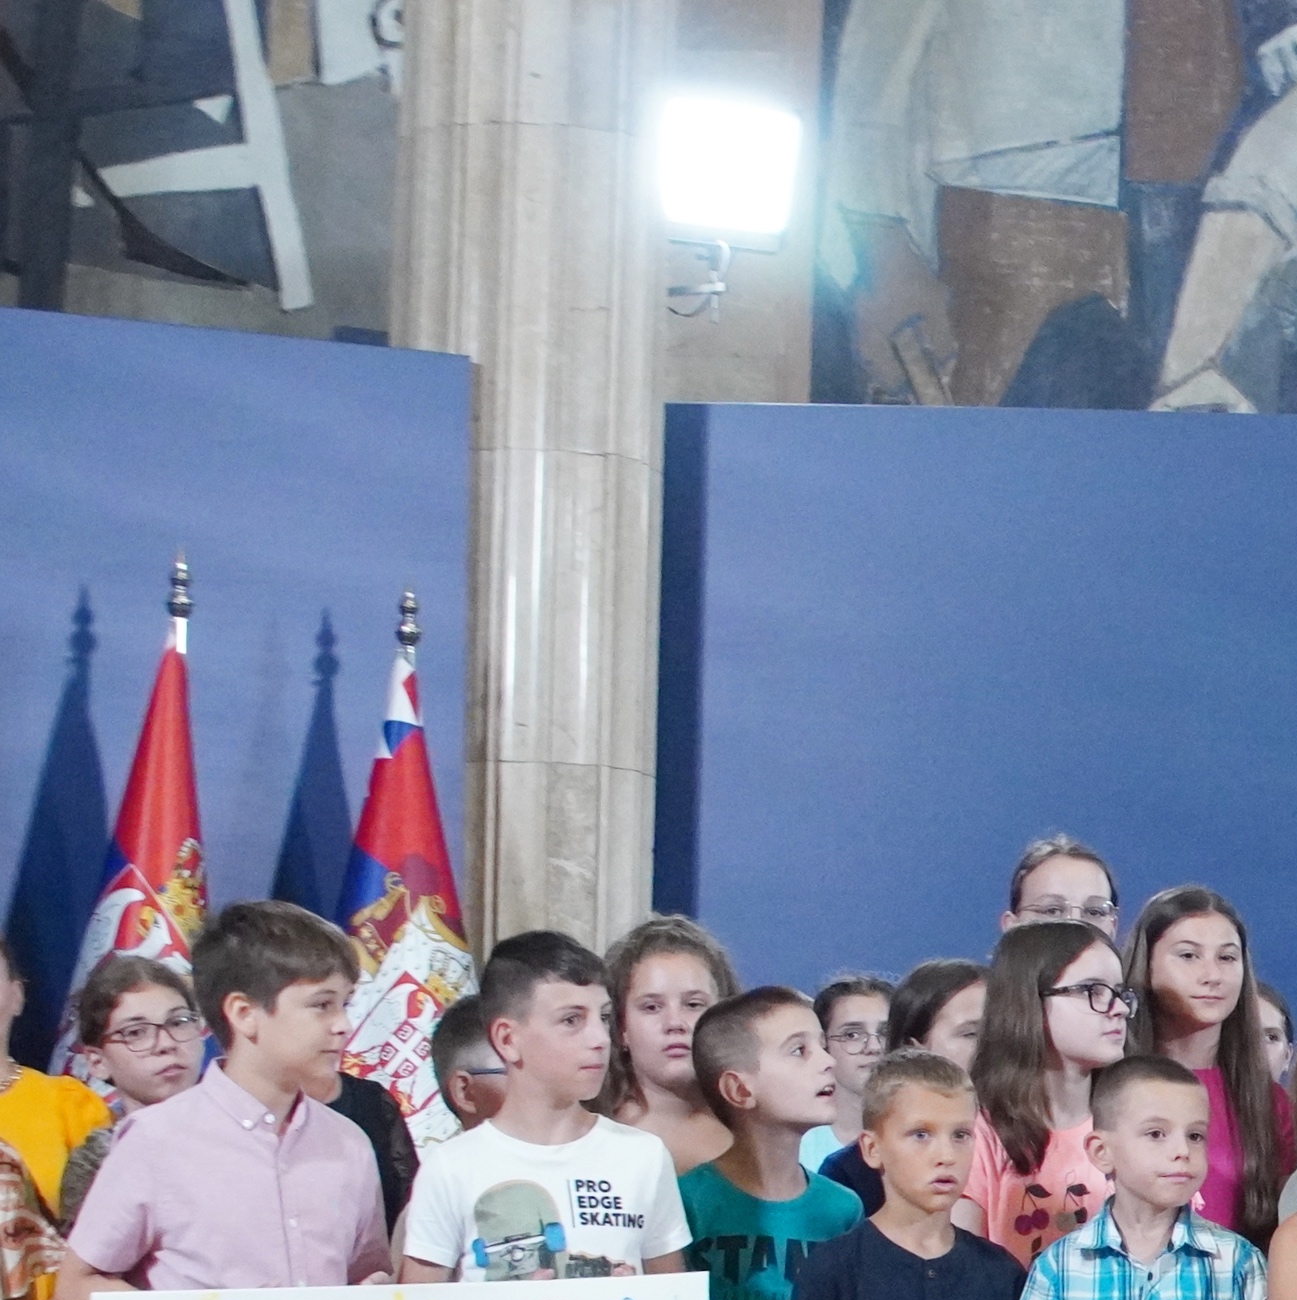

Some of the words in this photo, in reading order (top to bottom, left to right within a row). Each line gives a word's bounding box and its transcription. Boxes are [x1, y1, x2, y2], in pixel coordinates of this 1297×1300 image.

[575, 1179, 612, 1193] PRO
[577, 1195, 623, 1210] EDGE
[579, 1211, 645, 1229] SKATING
